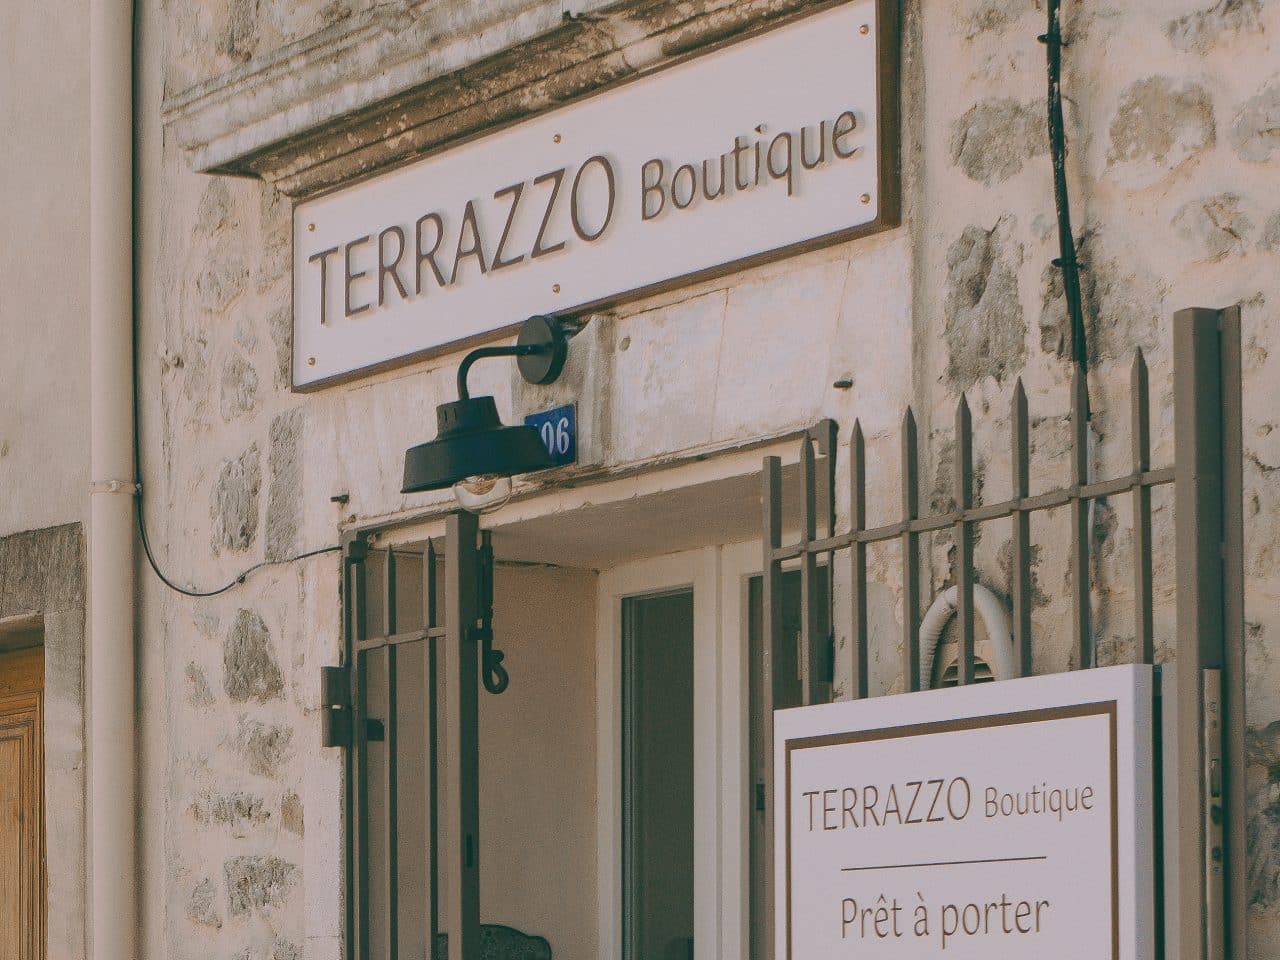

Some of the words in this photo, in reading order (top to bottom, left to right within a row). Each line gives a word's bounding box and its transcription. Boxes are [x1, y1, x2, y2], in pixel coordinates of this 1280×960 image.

[308, 155, 616, 325] TERRAZZO
[640, 109, 859, 221] Boutique
[534, 416, 570, 455] 06
[802, 777, 972, 832] TERRAZZO
[984, 782, 1095, 822] Boutique
[840, 893, 903, 939] Prêt
[912, 891, 931, 937] à
[941, 892, 1050, 950] porter
